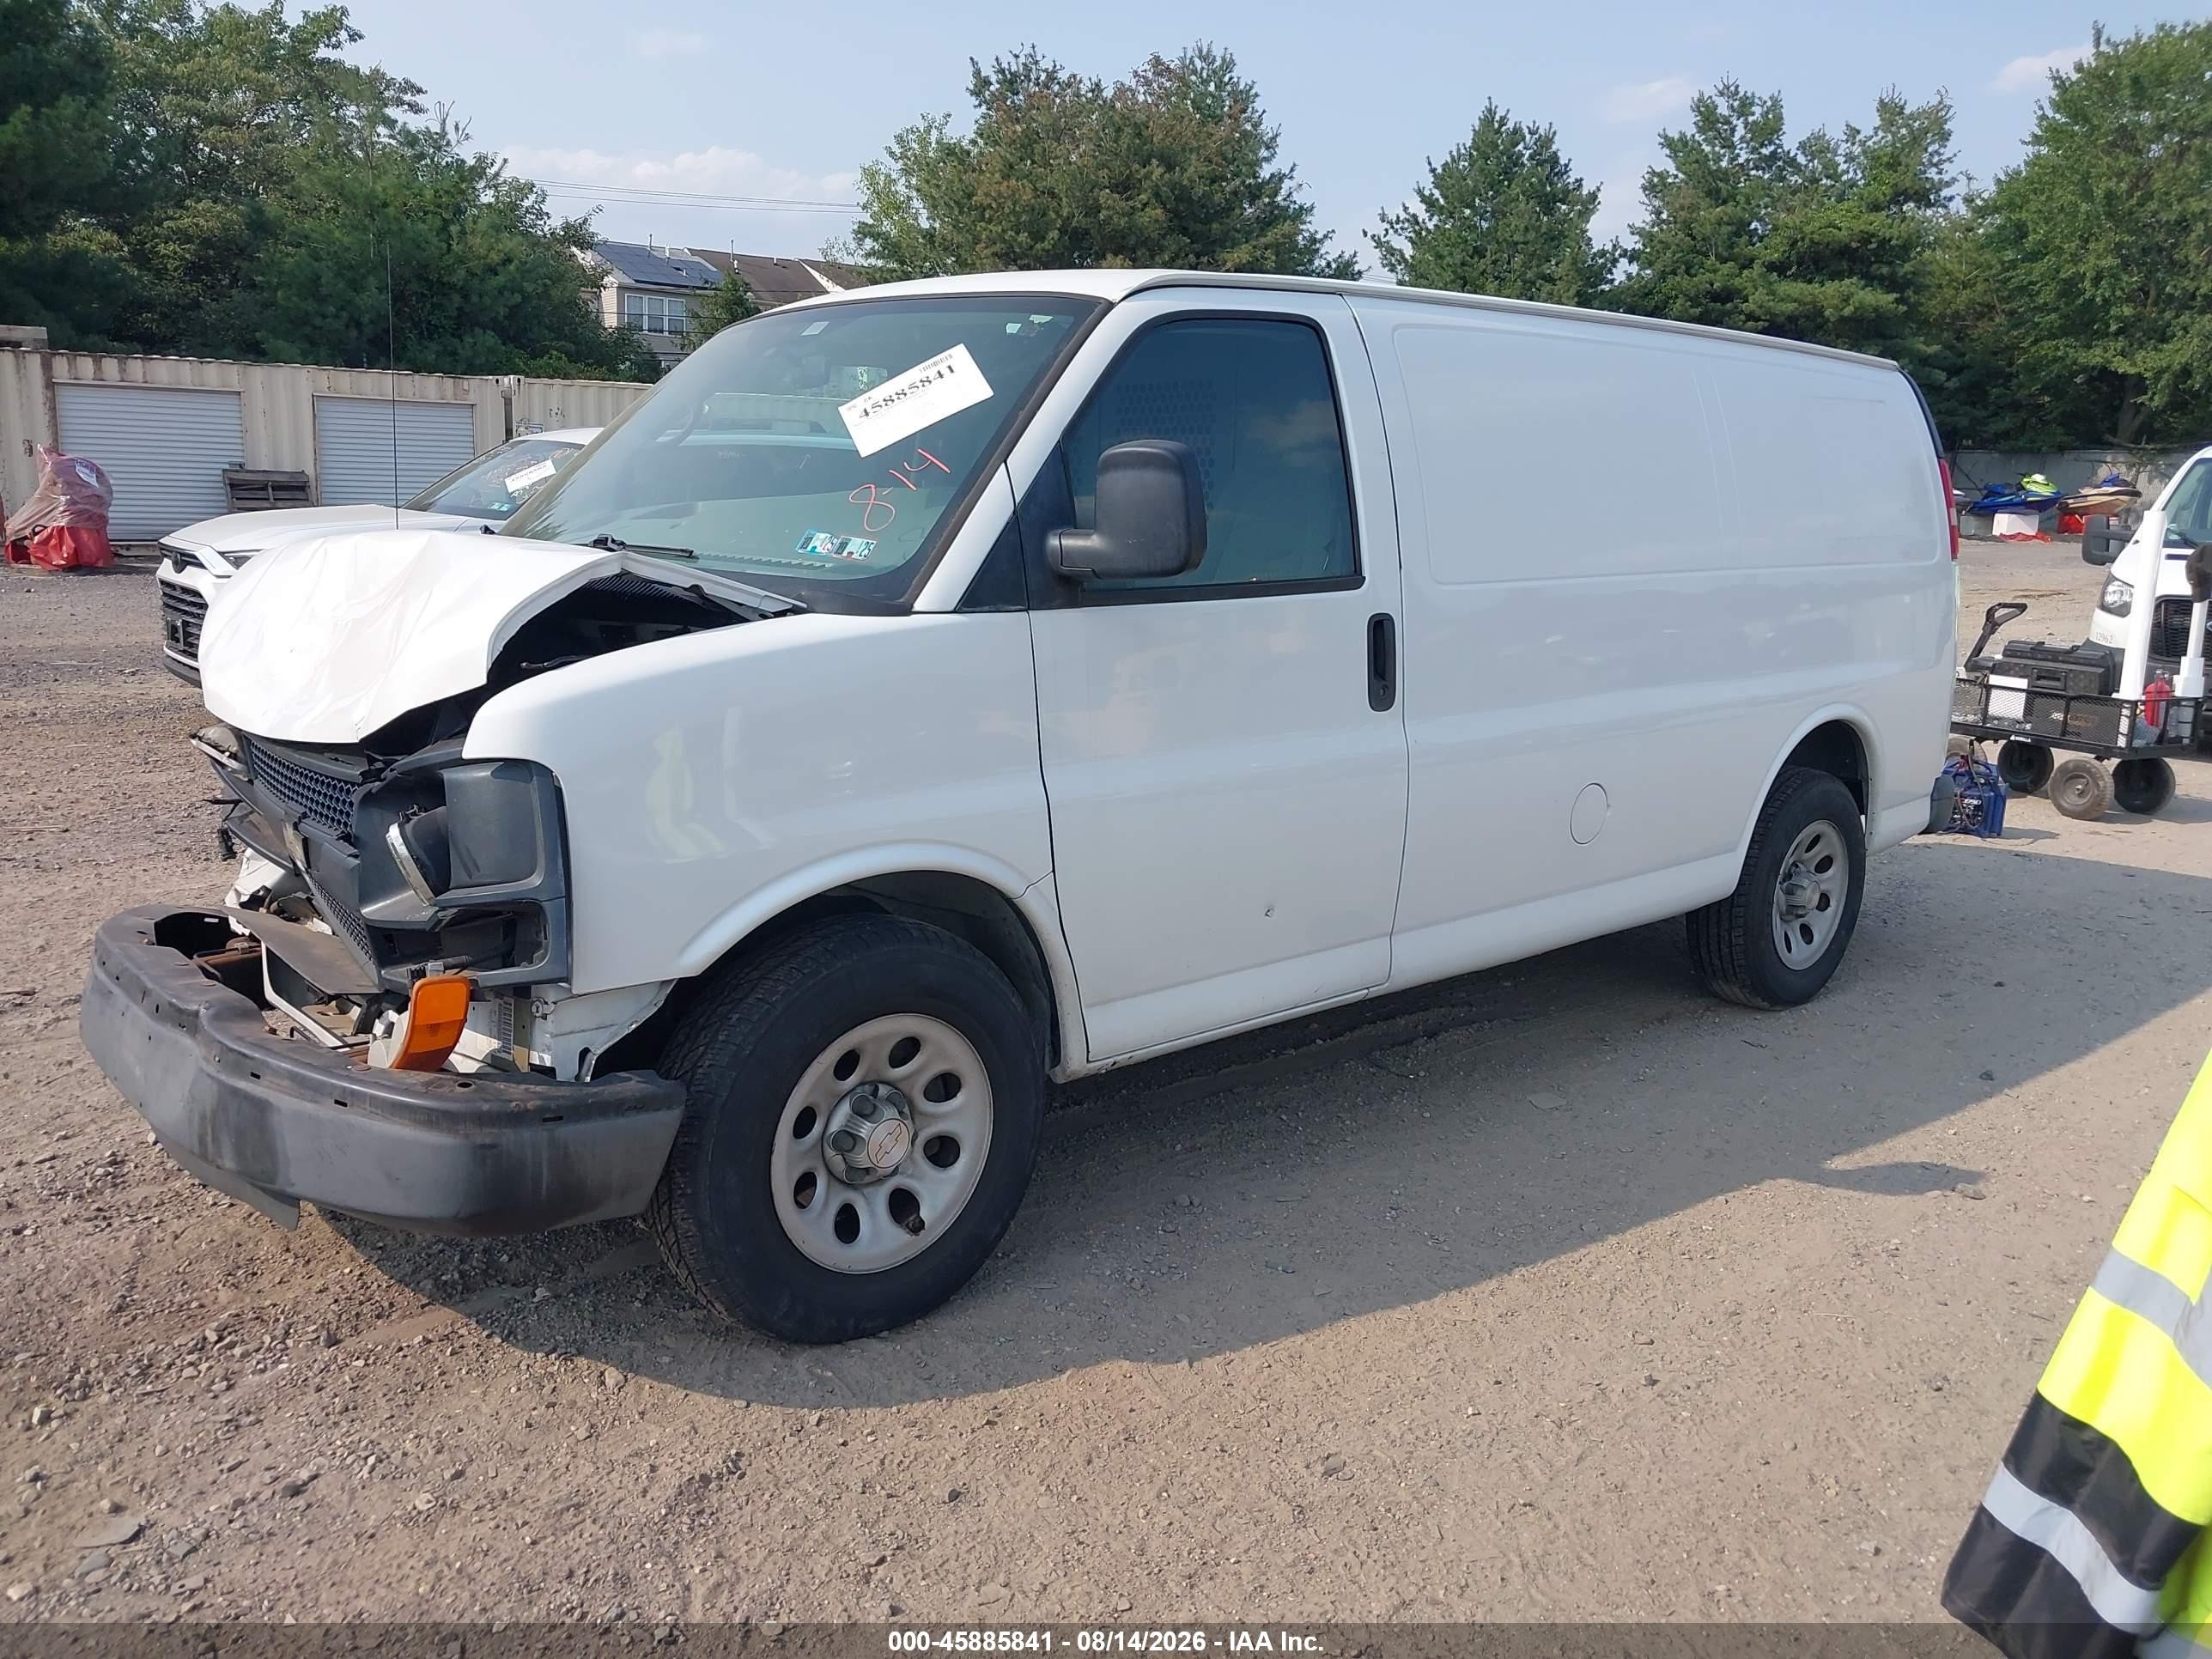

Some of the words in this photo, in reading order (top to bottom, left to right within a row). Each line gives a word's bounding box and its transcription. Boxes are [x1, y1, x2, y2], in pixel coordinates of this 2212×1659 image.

[859, 364, 957, 420] 45885841
[848, 448, 951, 532] 8-14
[859, 541, 875, 558] 25
